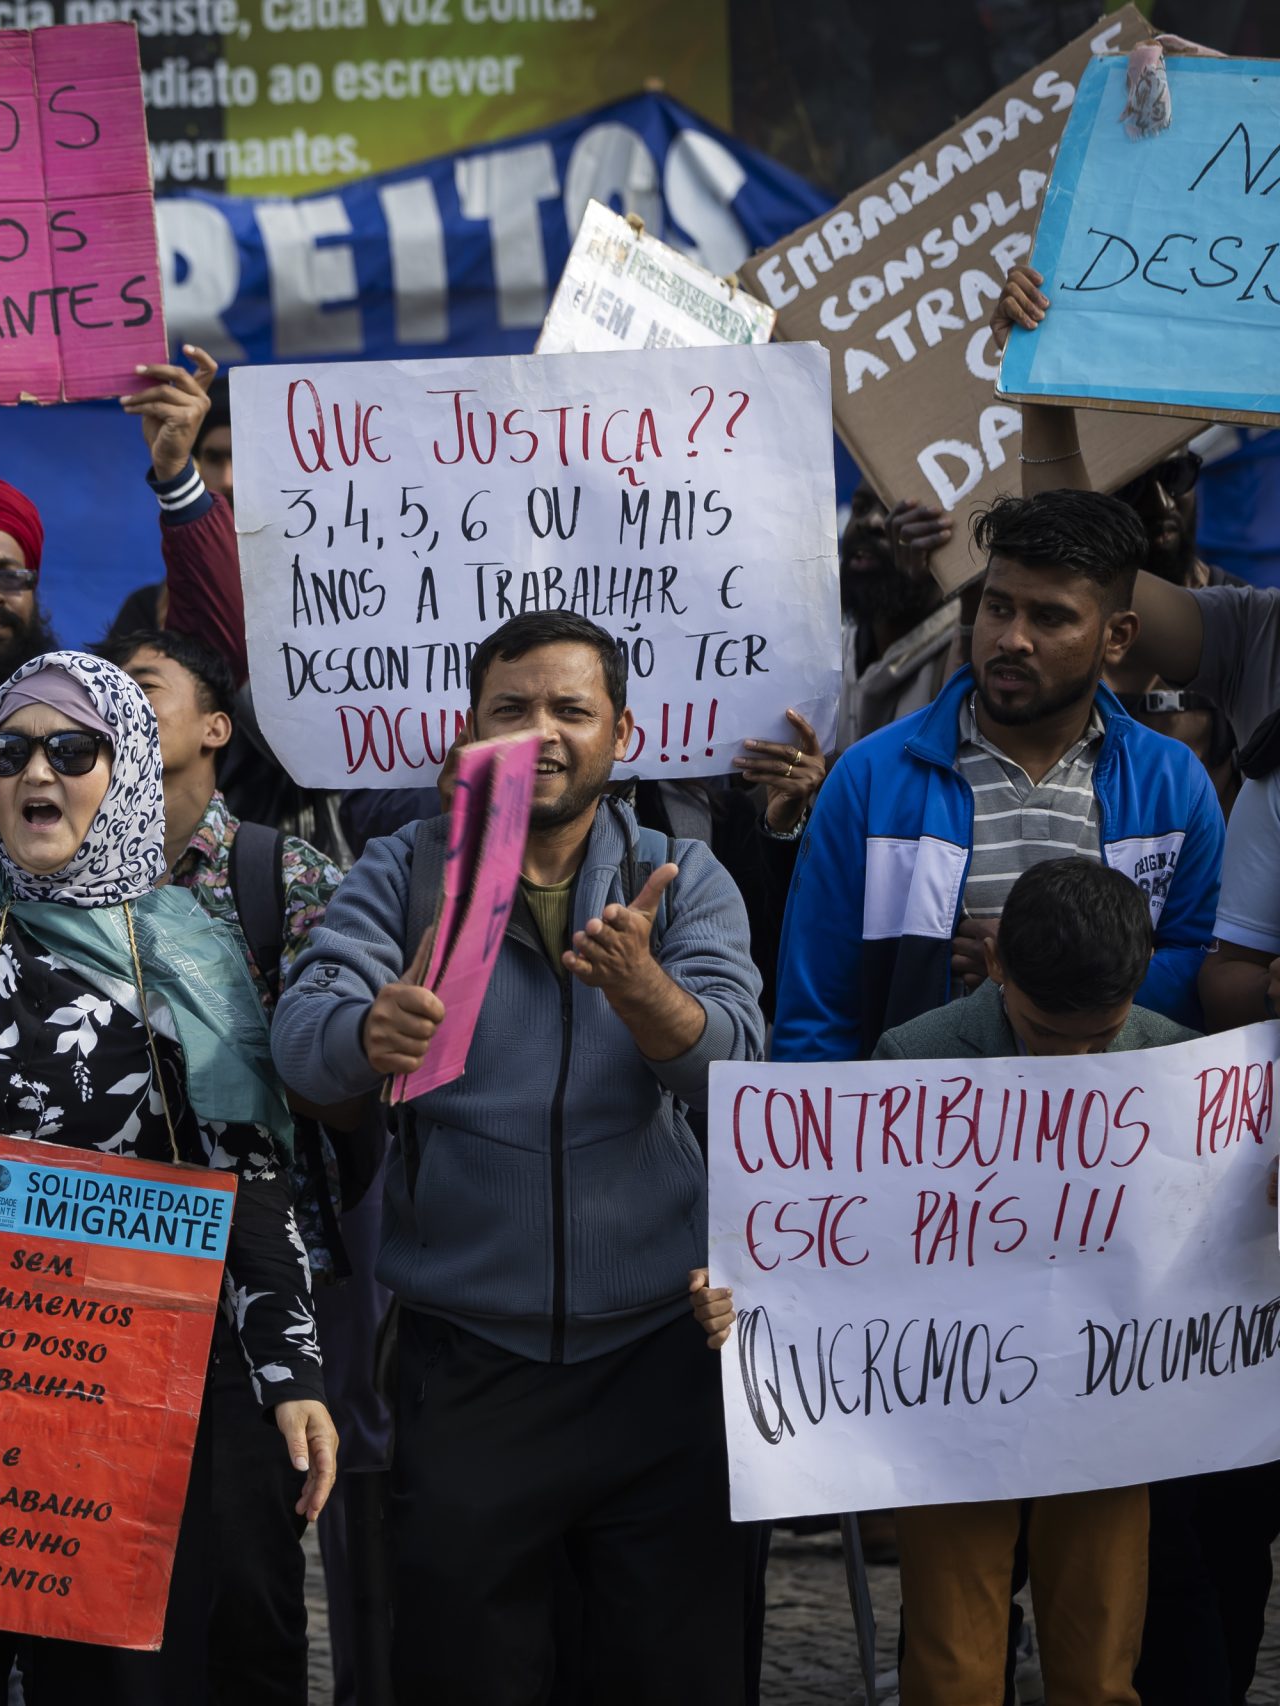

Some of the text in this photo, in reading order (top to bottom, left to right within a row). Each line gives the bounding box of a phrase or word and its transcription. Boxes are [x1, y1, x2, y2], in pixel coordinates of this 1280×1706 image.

[262, 0, 367, 30] cada
[380, 0, 451, 25] voz
[268, 63, 322, 105] ao
[333, 54, 524, 98] escrever
[756, 71, 1076, 310] EMBAIXADAS
[820, 146, 1056, 331] CONSULA
[287, 378, 391, 474] QUE
[527, 486, 580, 540] OU
[292, 554, 386, 628] ANOS
[464, 562, 688, 622] TRABALHAR
[686, 630, 770, 682] TER
[1194, 1060, 1273, 1156] PARA
[26, 1171, 225, 1220] SOLIDARIEDADE
[24, 1195, 220, 1252] IMIGRANTE
[745, 1194, 869, 1271] ESTE
[10, 1249, 73, 1278] SEM
[22, 1332, 107, 1365] POSSO
[735, 1294, 1280, 1445] QUEREMOS DOCUMENTO
[2, 1447, 20, 1467] E
